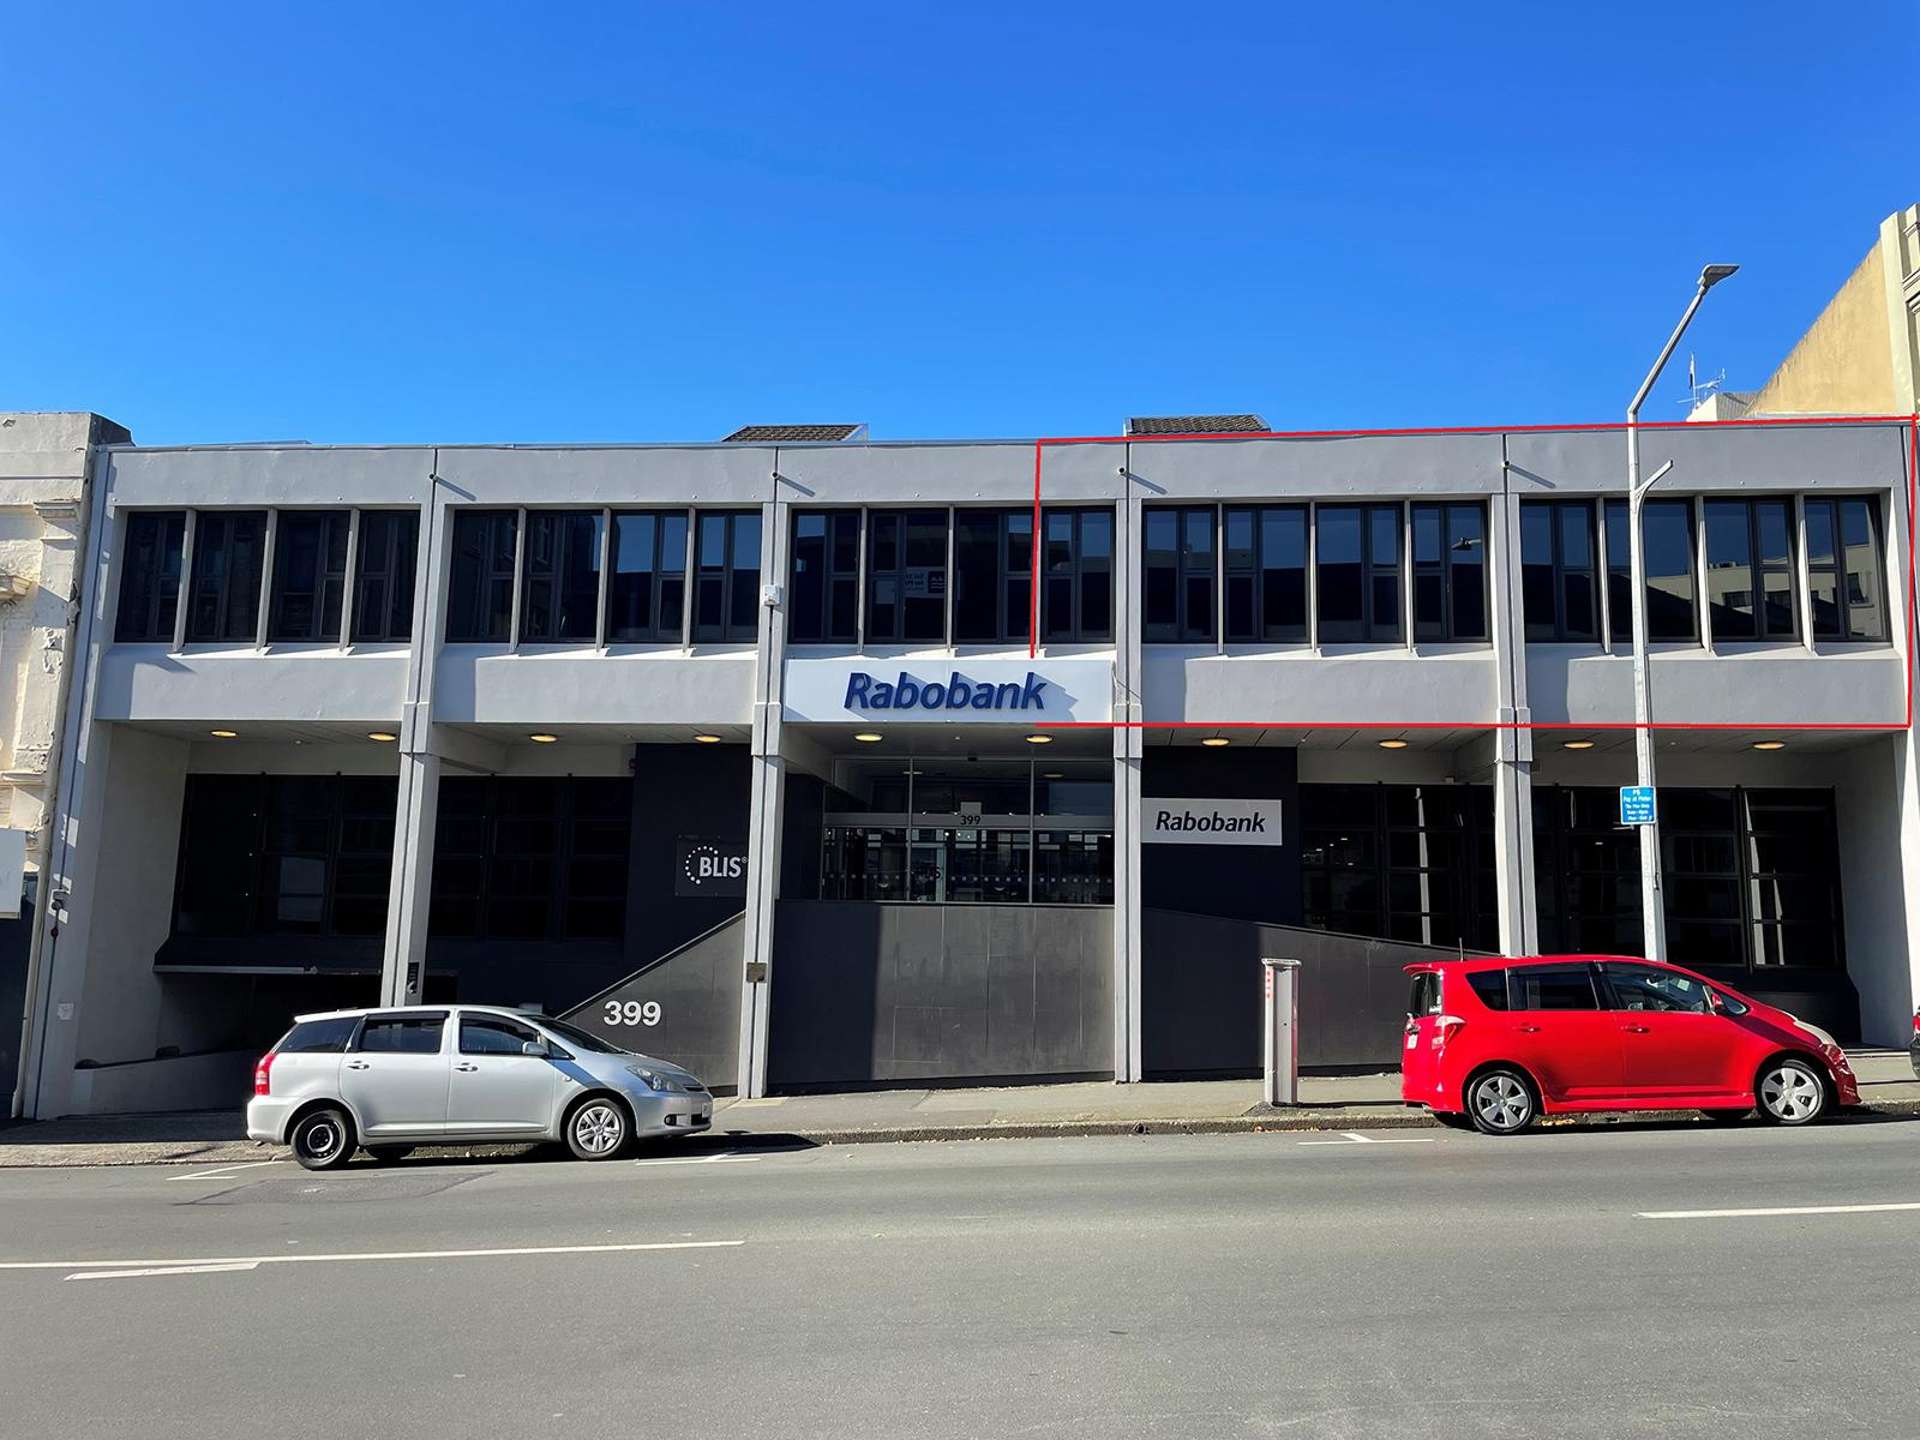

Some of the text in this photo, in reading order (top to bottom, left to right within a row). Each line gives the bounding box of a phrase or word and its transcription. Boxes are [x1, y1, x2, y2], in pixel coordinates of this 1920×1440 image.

[843, 671, 1048, 710] Rabobank
[960, 815, 981, 825] 399
[1155, 810, 1266, 833] Rabobank
[603, 1000, 662, 1027] 399
